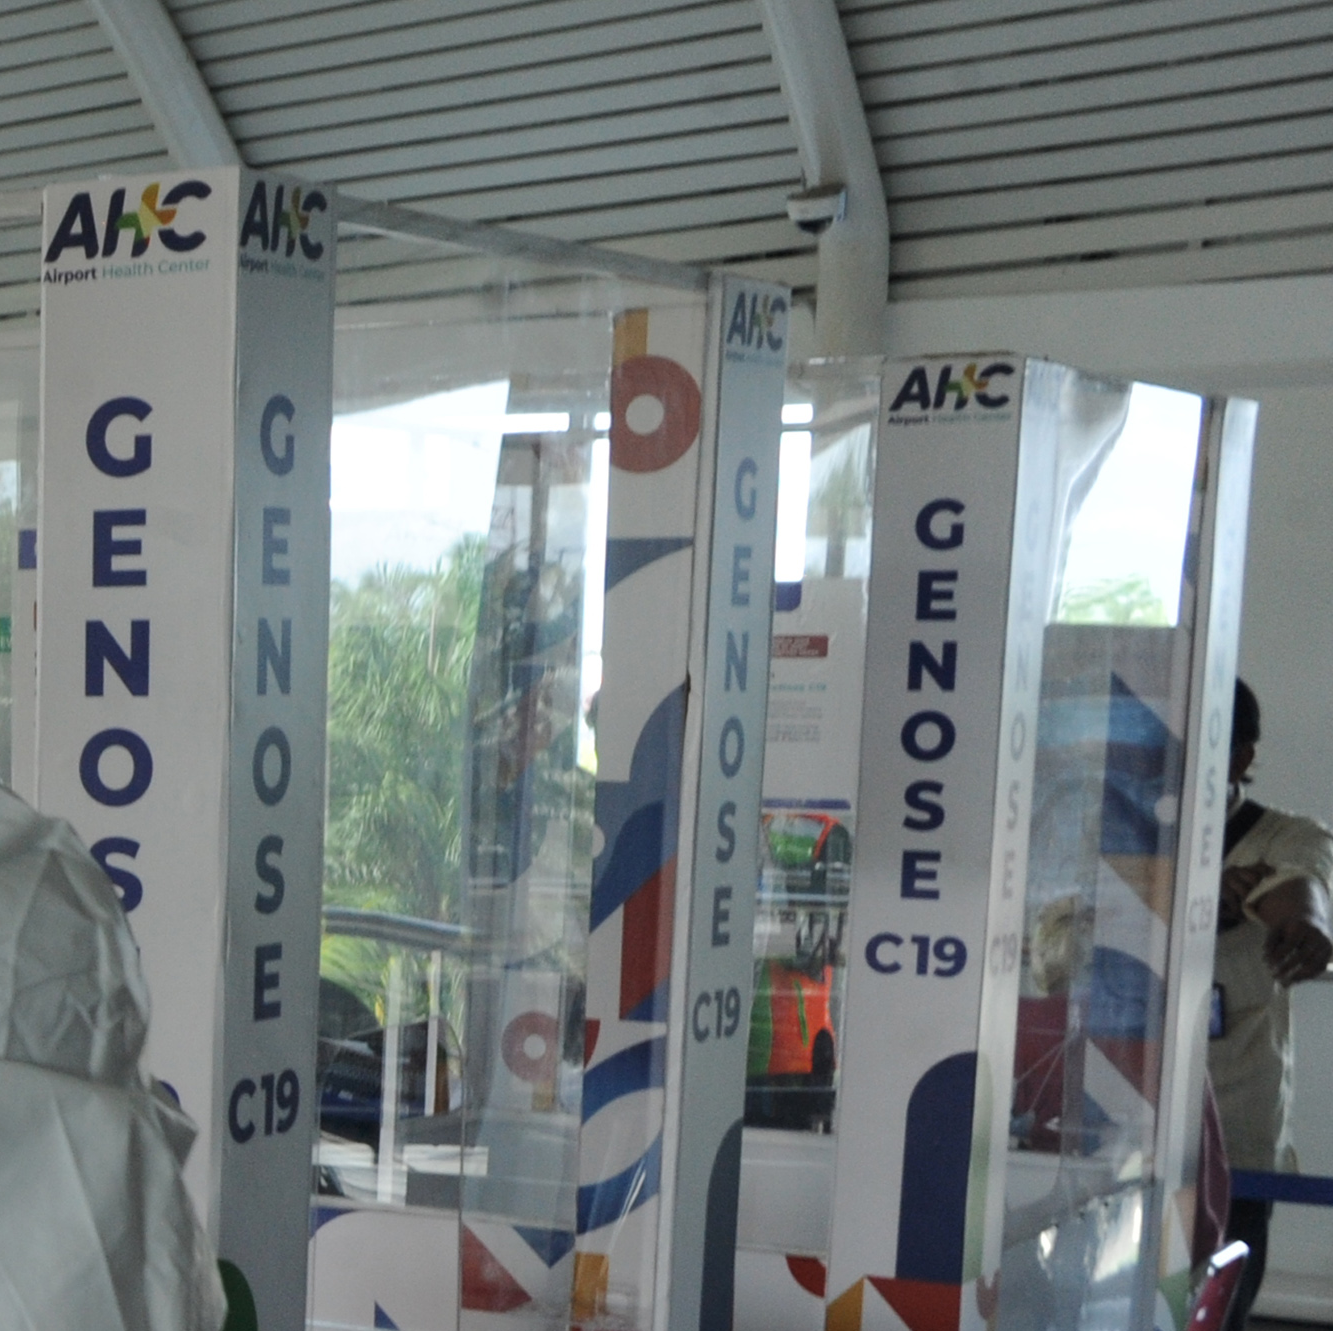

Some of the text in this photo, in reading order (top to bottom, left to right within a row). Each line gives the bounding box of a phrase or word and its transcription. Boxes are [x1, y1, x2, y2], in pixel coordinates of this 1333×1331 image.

[44, 180, 212, 263] AHC
[43, 257, 210, 286] Airport Health Center
[889, 362, 1015, 412] AHC
[79, 396, 154, 913] GENOS
[251, 394, 296, 1022] GENOSE
[710, 457, 758, 947] GENOSE
[899, 498, 965, 901] GENOSE
[864, 932, 969, 978] C19
[692, 987, 741, 1043] C19
[228, 1069, 300, 1145] C19
